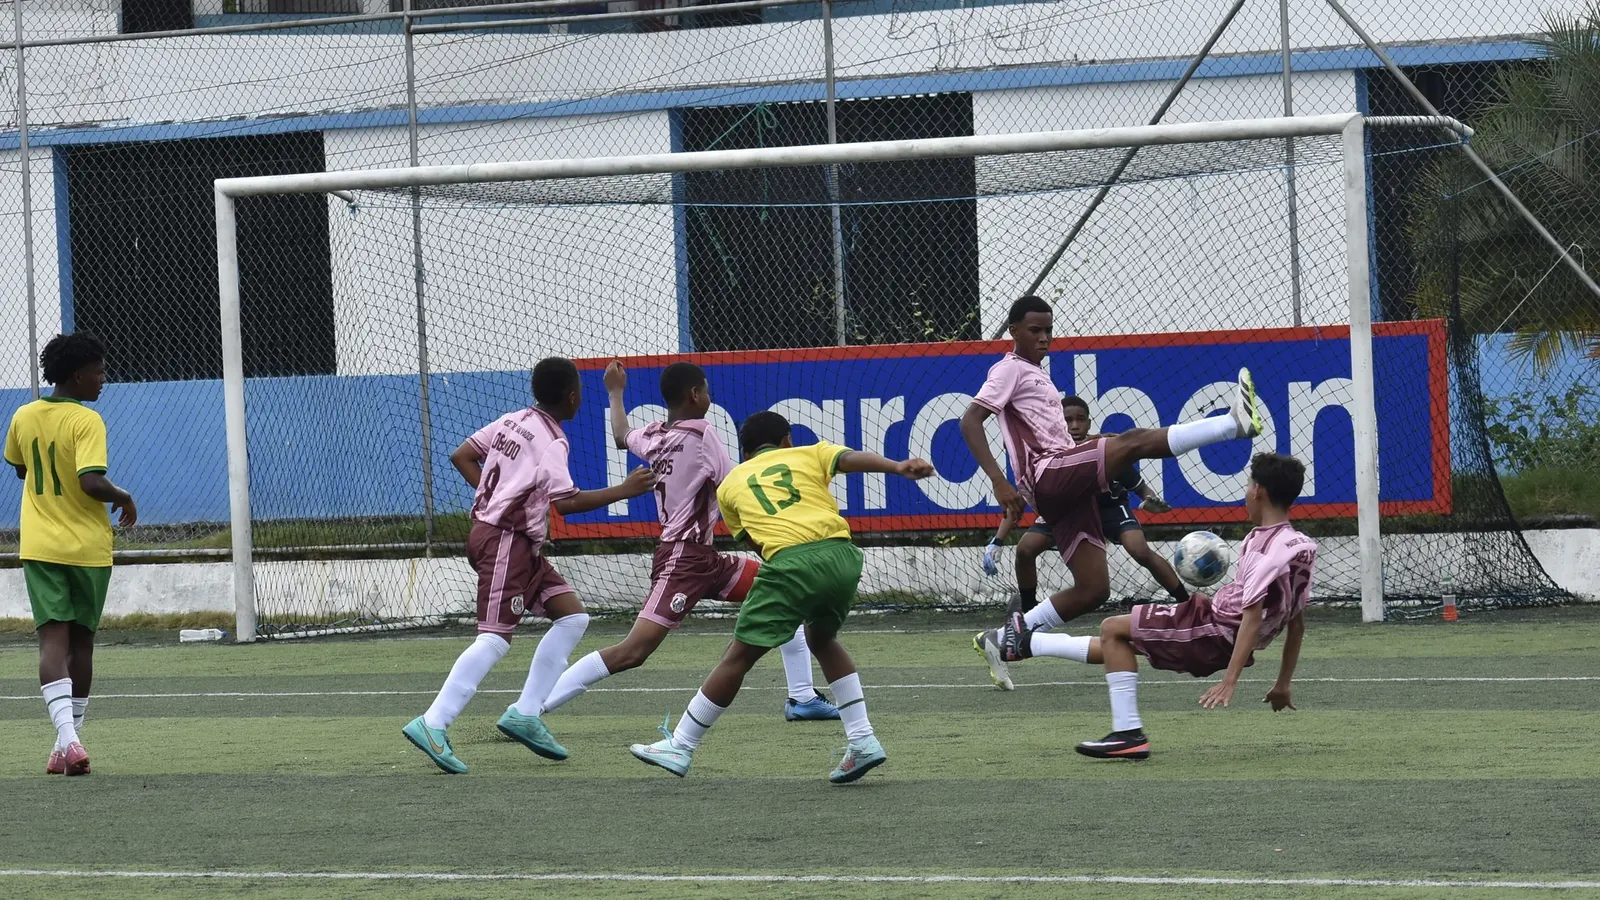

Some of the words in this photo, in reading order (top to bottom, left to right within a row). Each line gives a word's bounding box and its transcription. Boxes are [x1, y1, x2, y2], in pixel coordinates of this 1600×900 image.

[605, 353, 1379, 516] marahon
[32, 437, 62, 496] 11
[747, 464, 801, 515] 13
[1119, 505, 1129, 518] 1
